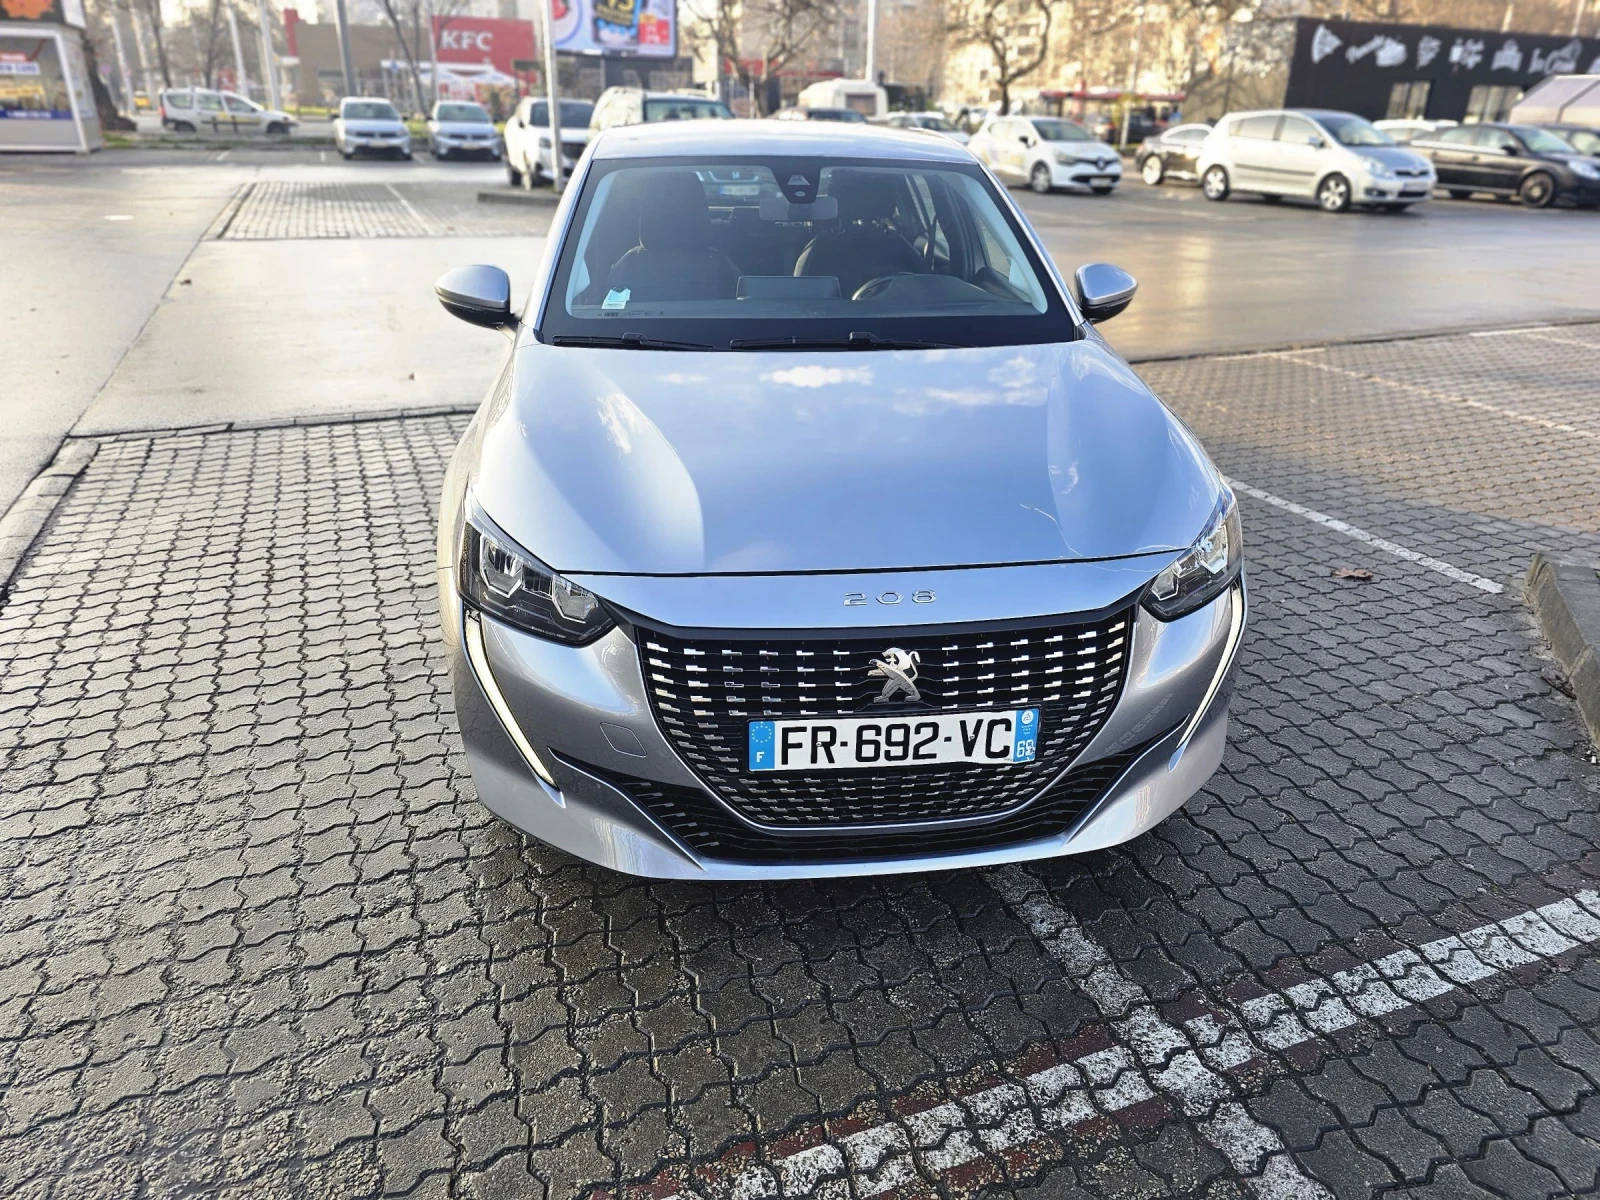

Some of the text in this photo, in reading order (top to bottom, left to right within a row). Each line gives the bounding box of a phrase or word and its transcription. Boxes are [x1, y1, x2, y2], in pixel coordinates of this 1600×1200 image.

[441, 29, 493, 52] KFC
[843, 589, 937, 606] 208
[781, 718, 1012, 765] FR-692-VC
[756, 751, 765, 763] F
